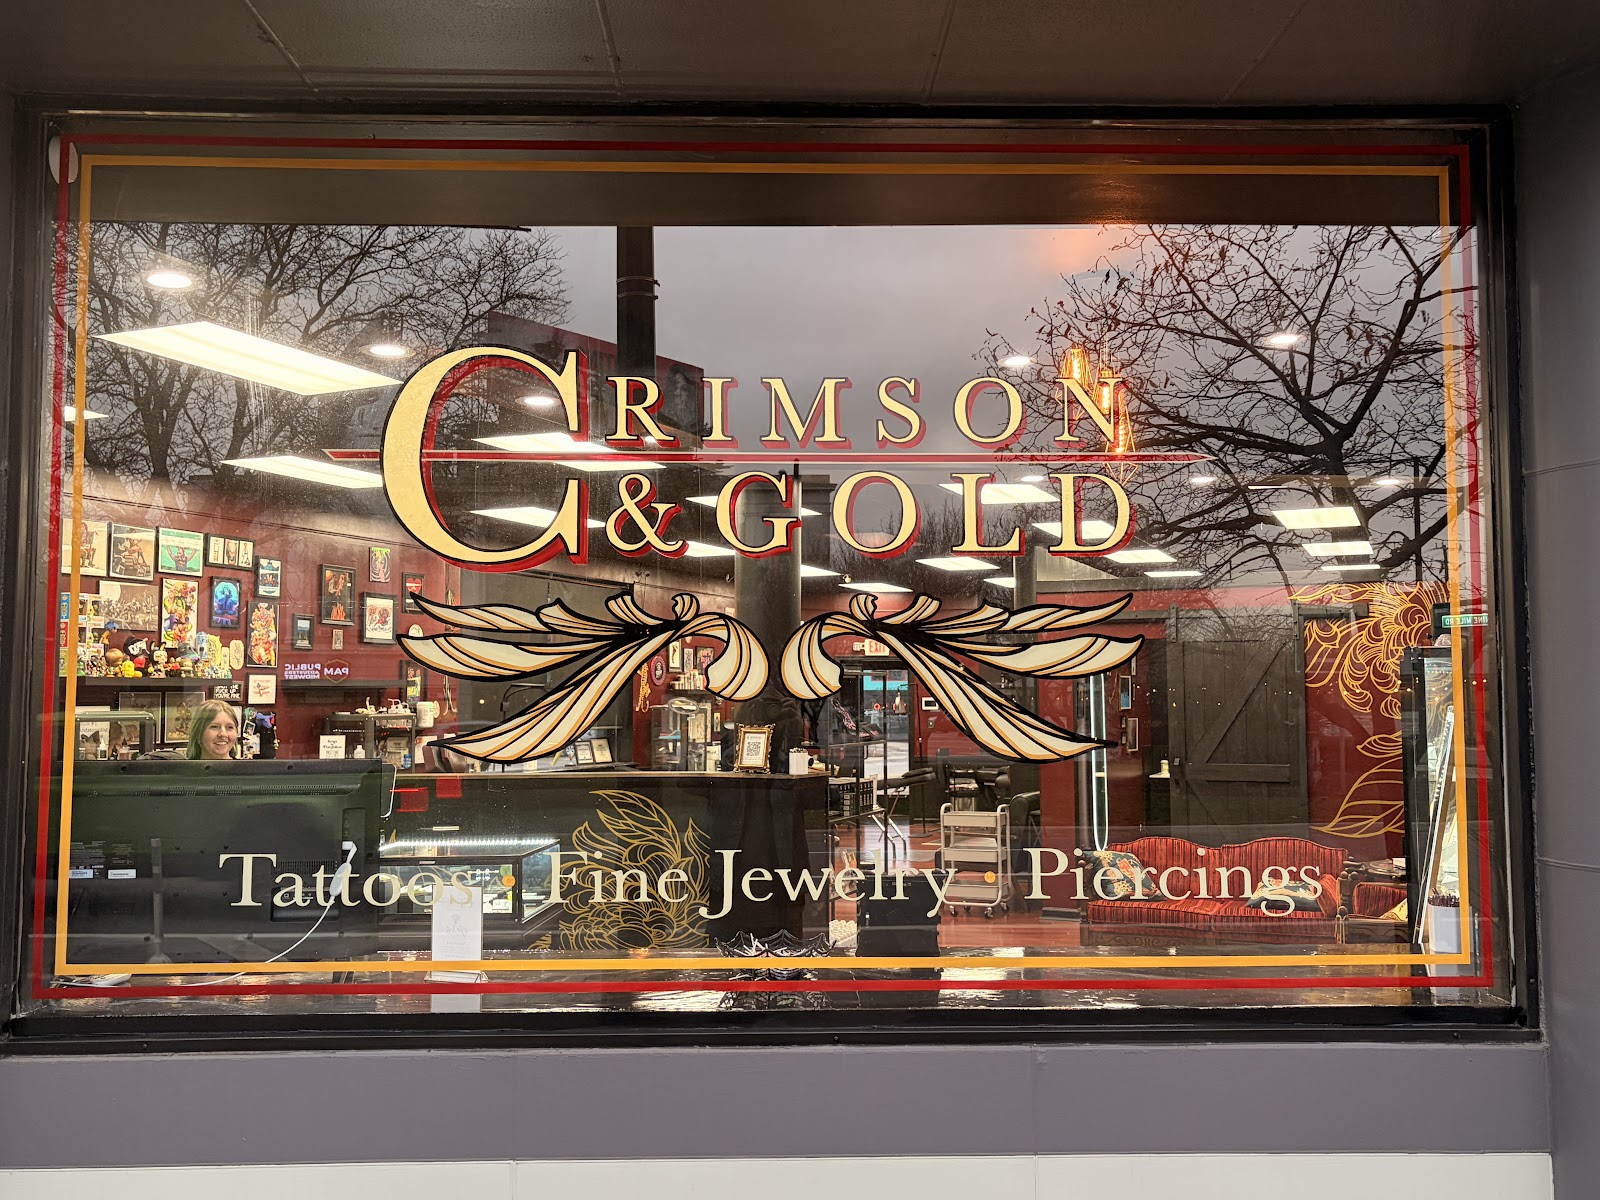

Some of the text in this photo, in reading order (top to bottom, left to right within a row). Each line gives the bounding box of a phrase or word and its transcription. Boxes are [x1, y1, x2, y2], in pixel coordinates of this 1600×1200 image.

[605, 470, 1137, 559] & GOLD
[219, 847, 1323, 919] Tattoos Fine Jewelry Piercings
